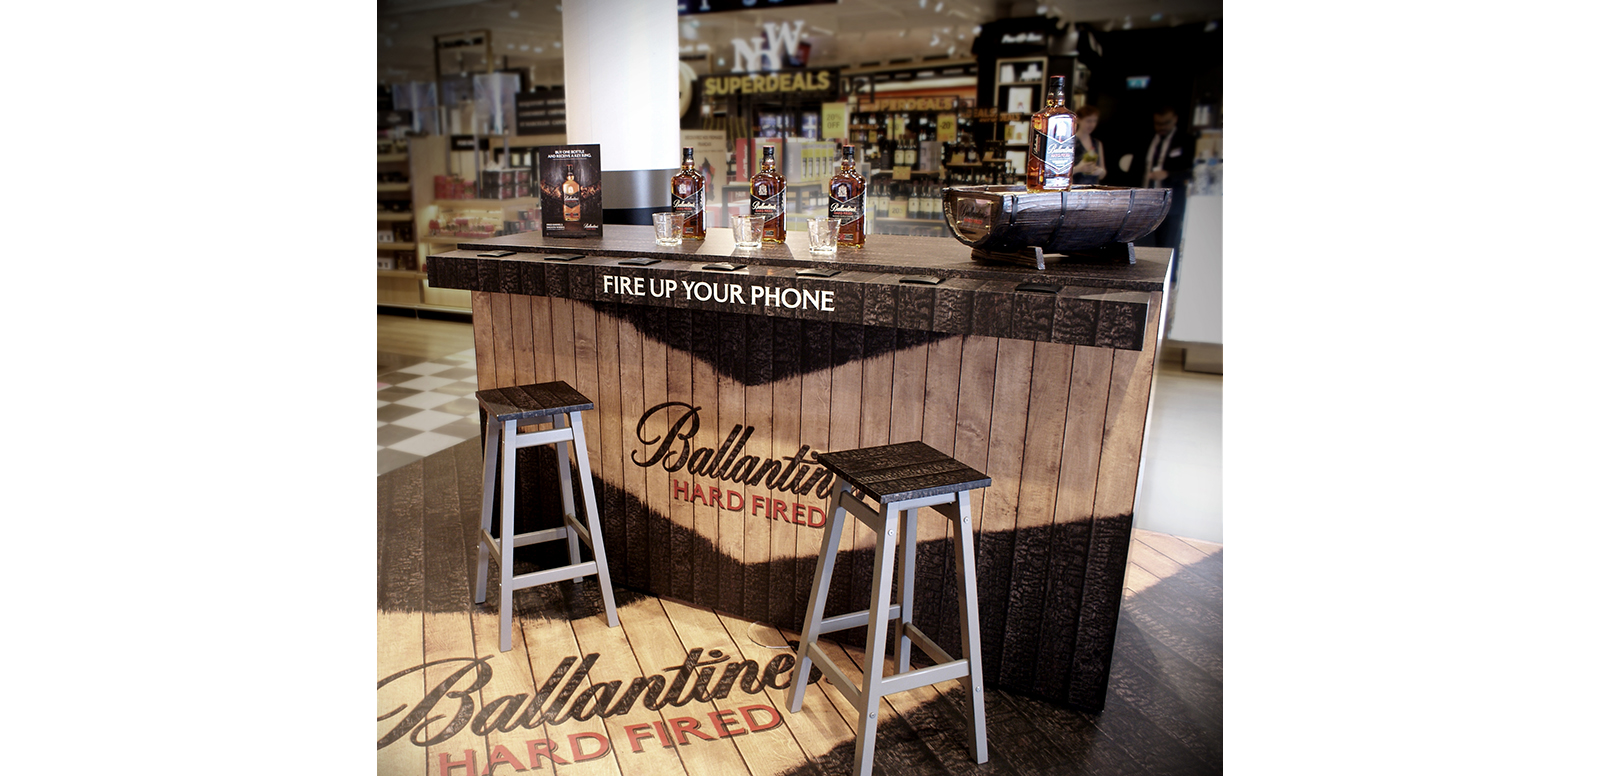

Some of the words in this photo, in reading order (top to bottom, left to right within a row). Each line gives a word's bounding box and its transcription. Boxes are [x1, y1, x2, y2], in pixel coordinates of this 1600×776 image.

[705, 71, 830, 95] SUPERDEALS
[603, 275, 646, 296] FIRE
[650, 278, 678, 298] UP
[682, 280, 746, 305] YOUR
[751, 285, 835, 312] PHONE
[673, 479, 745, 512] HARD
[752, 494, 827, 529] FIRED
[438, 731, 612, 776] HARD
[624, 703, 785, 753] FIRED
